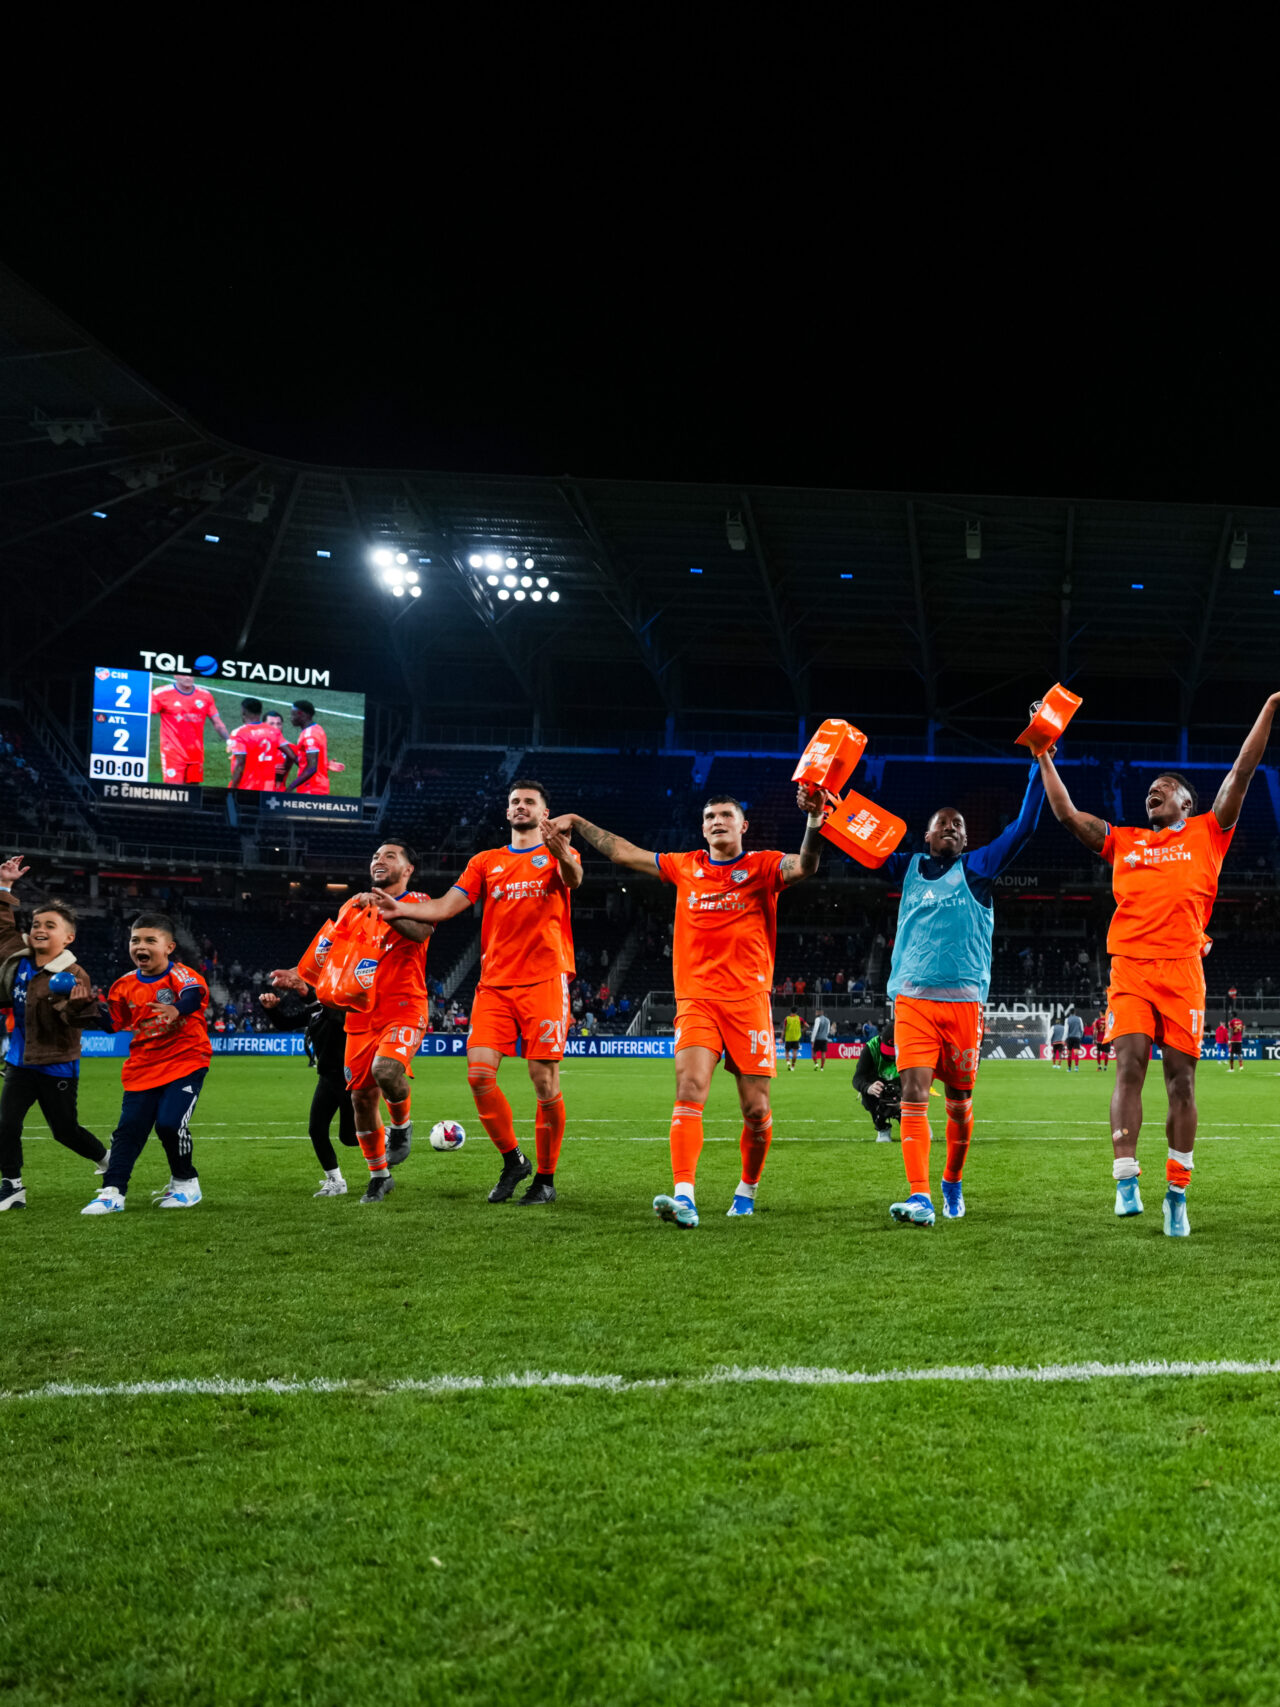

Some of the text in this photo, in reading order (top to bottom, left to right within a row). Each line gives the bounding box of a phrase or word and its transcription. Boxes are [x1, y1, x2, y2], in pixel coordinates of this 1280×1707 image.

[110, 671, 128, 680] CIN
[140, 651, 330, 687] TQL STADIUM
[115, 685, 132, 708] 2
[107, 715, 127, 725] ATL
[112, 728, 130, 752] 2
[93, 759, 144, 778] 90:00
[104, 784, 189, 802] FC CINCINNATI
[282, 800, 359, 812] MERCYHEALTH
[1144, 843, 1185, 857] MERCY
[1144, 852, 1191, 865] HEALTH
[506, 880, 543, 891] MERCY
[507, 889, 549, 901] HEALTH
[700, 901, 745, 910] HEALTH
[983, 1003, 1075, 1021] TADIUM
[389, 1025, 415, 1046] 10
[540, 1019, 562, 1043] 21
[80, 1036, 116, 1052] OMORROW
[228, 1037, 287, 1052] DIFFERENCE
[563, 1040, 586, 1054] AKE
[588, 1041, 597, 1054] A
[600, 1040, 665, 1055] DIFFERENCE
[748, 1030, 771, 1054] 19
